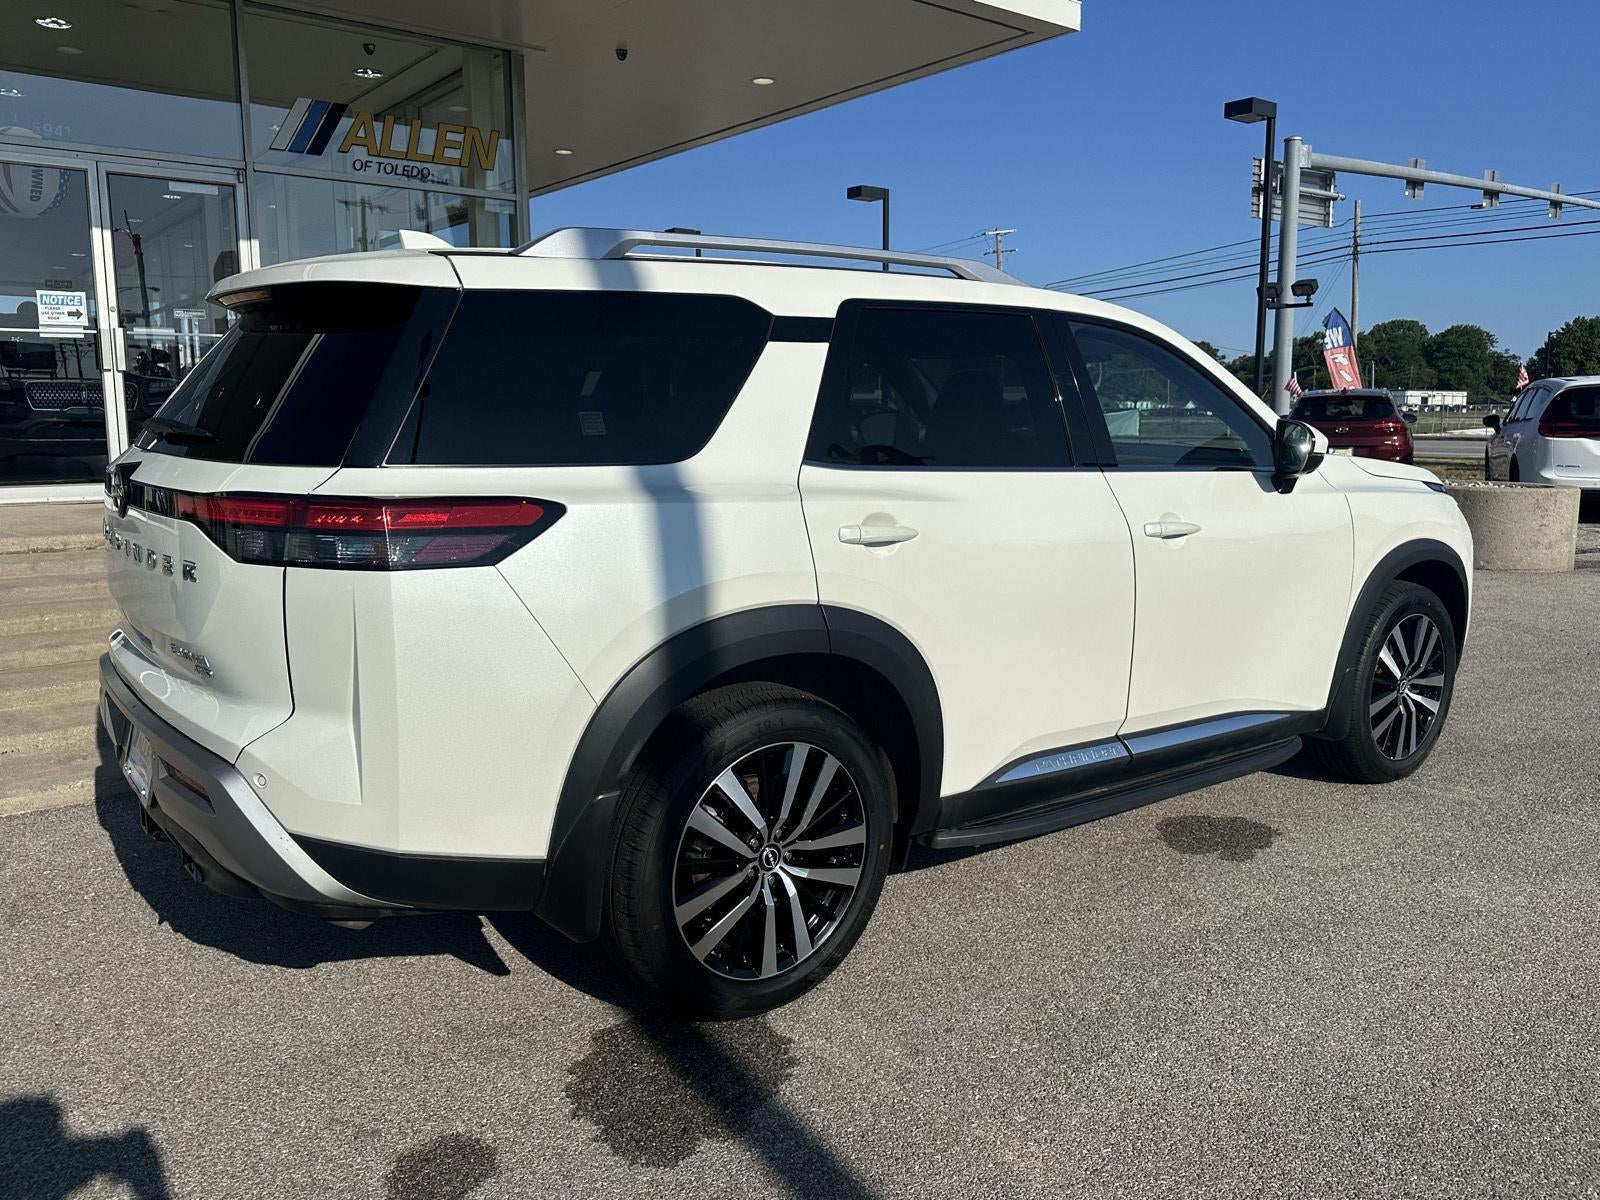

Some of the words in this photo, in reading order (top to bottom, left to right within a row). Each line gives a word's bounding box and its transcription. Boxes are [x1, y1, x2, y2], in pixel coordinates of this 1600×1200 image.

[338, 112, 500, 171] ALLEN
[352, 158, 374, 173] OF
[376, 162, 431, 179] TOLEDO
[42, 295, 81, 305] NOTICE
